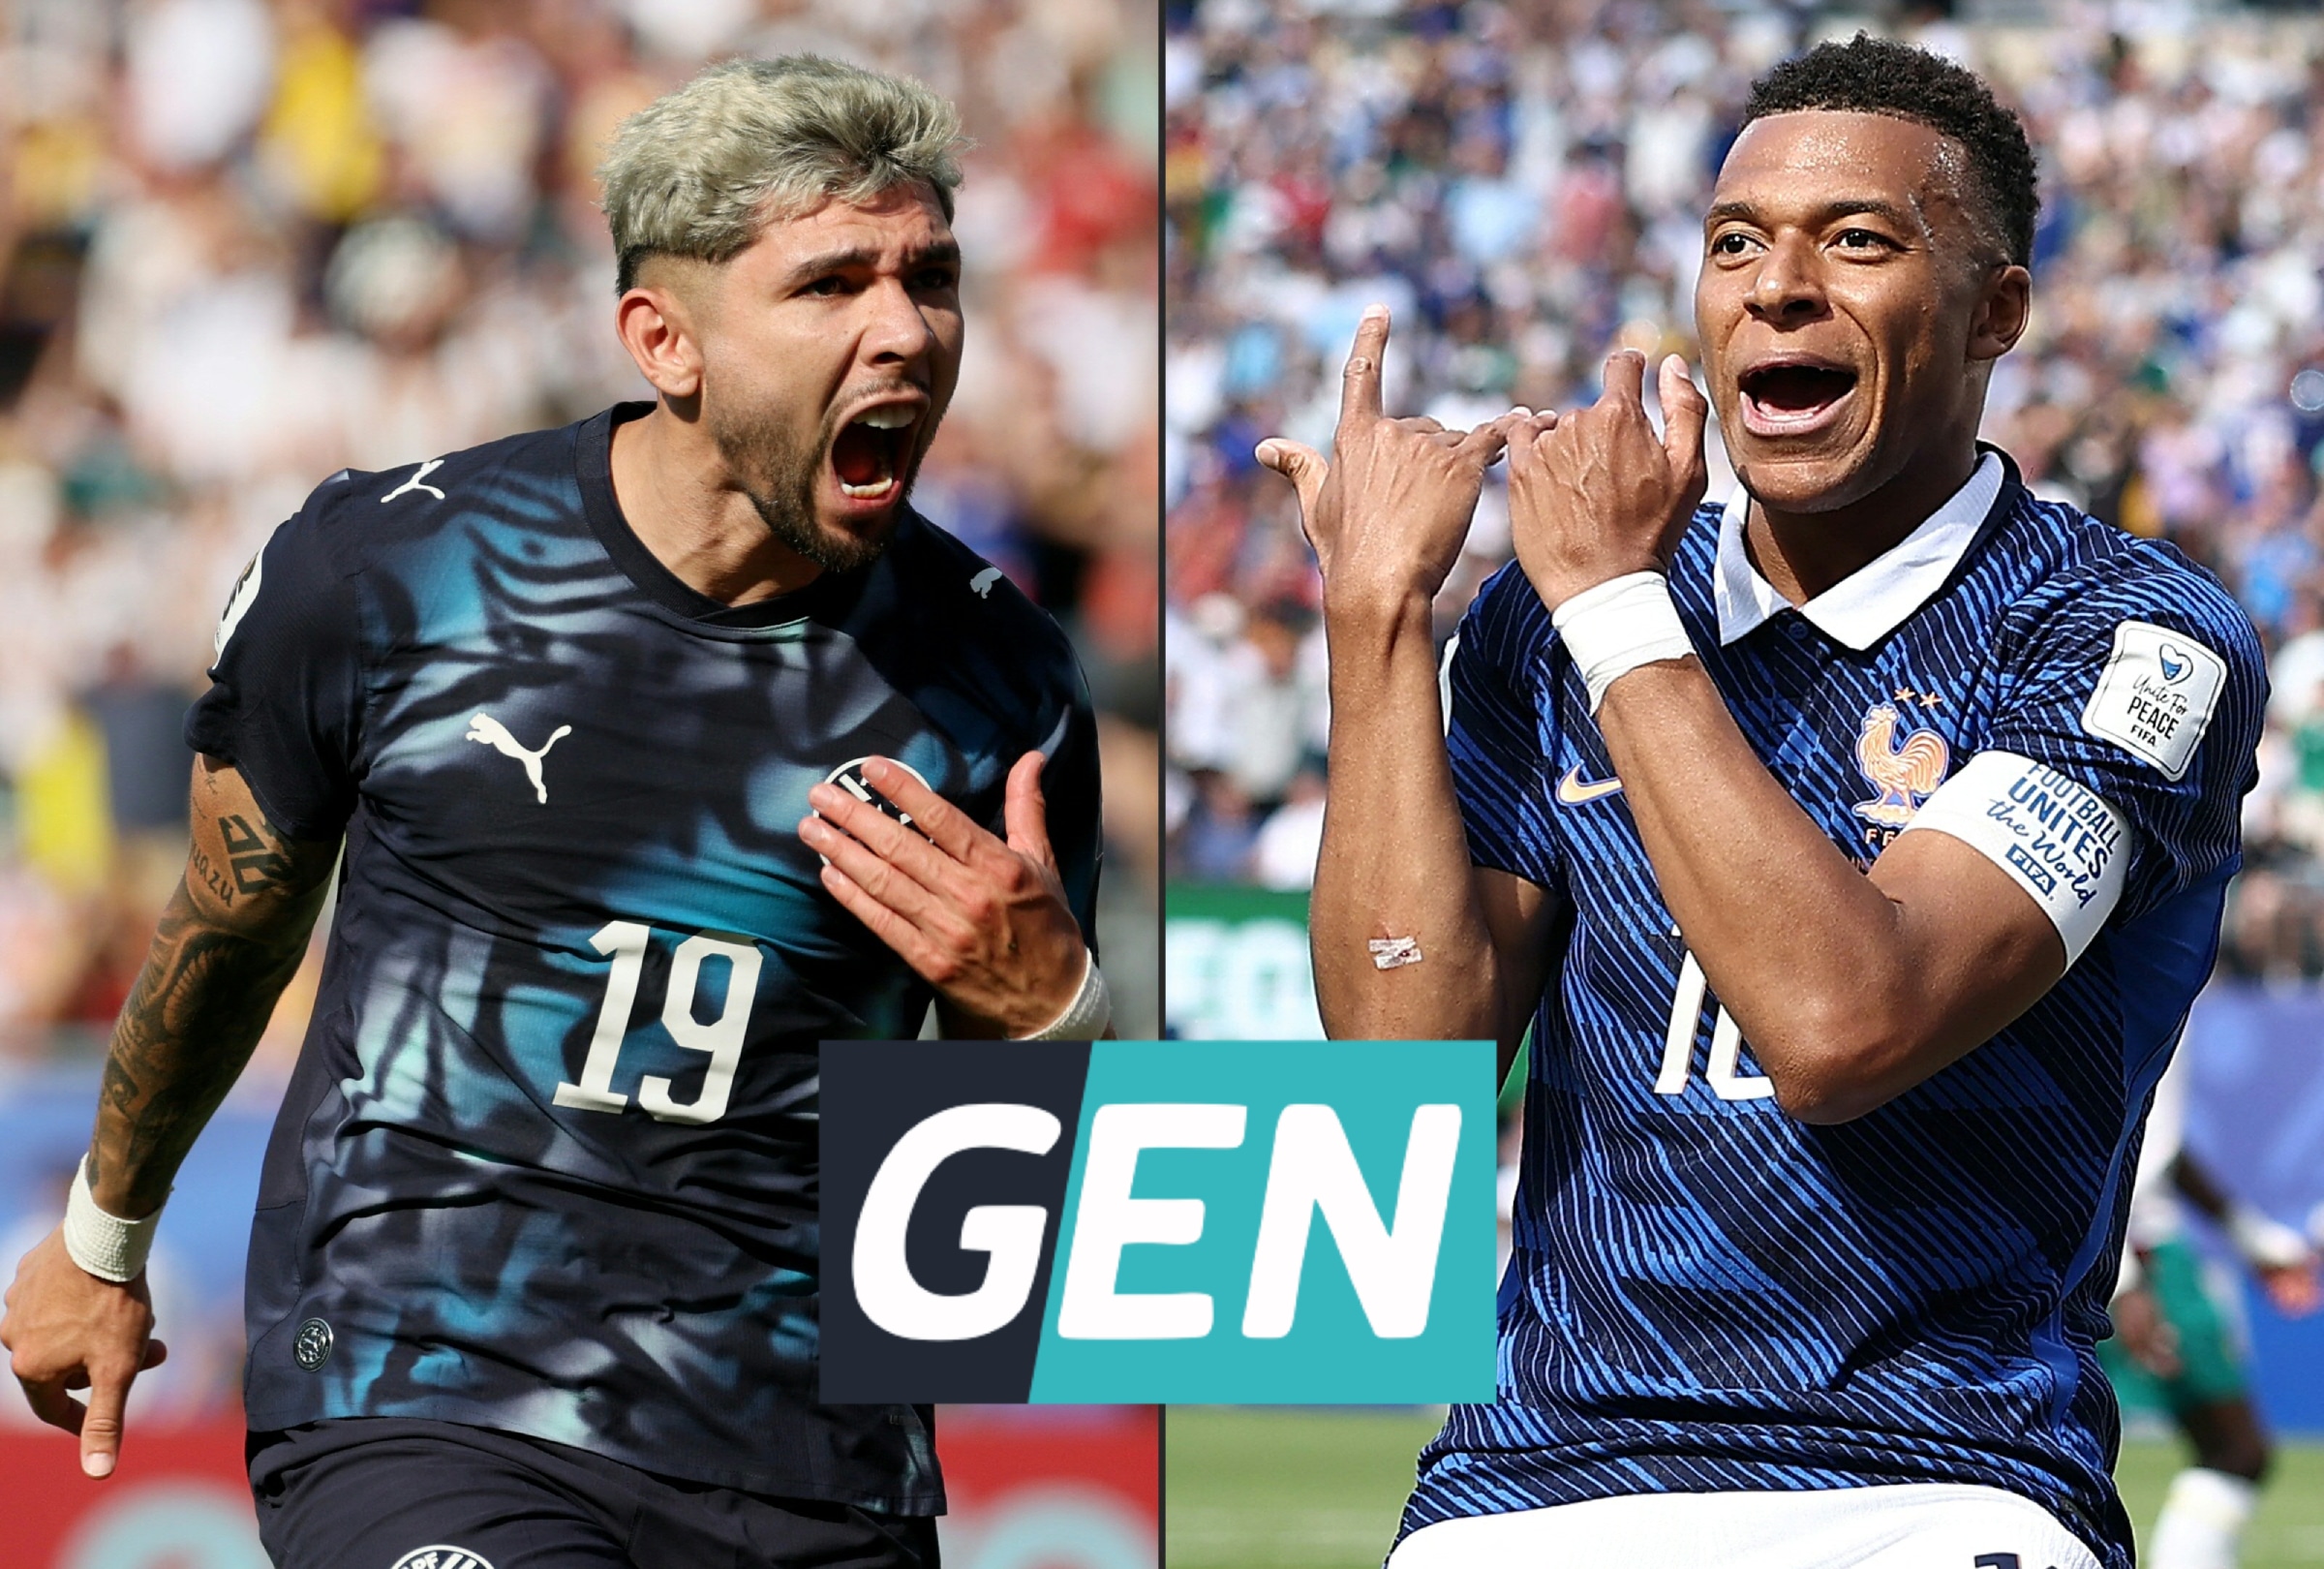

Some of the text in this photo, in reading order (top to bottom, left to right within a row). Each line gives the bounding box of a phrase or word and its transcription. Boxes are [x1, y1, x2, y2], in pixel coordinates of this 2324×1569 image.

[2126, 695, 2180, 740] PEACE
[2133, 673, 2188, 716] Unite For
[2130, 724, 2157, 747] FIFA
[2007, 776, 2108, 879] UNITES
[2027, 763, 2122, 855] FOOTBALL
[1986, 798, 2097, 909] the World
[2009, 846, 2055, 896] FIFA
[552, 919, 764, 1125] 19
